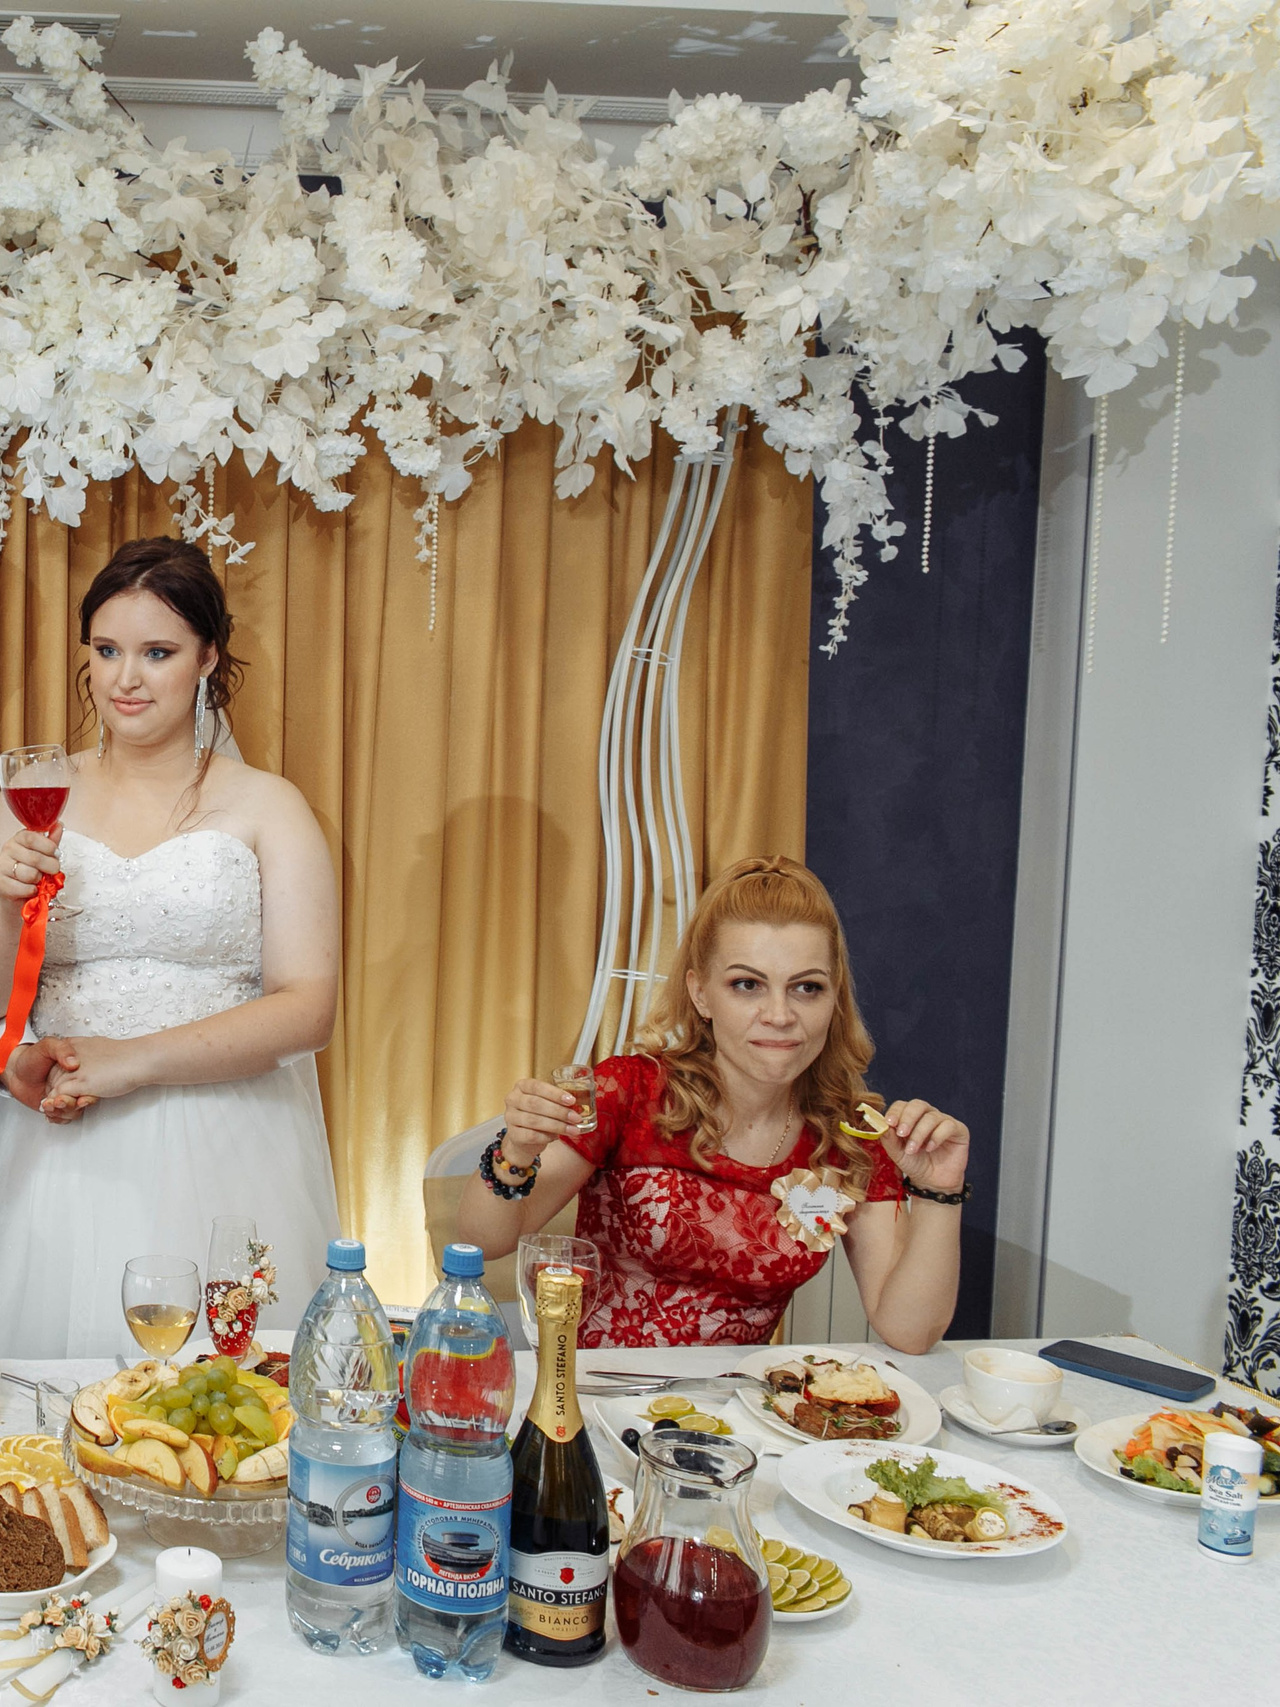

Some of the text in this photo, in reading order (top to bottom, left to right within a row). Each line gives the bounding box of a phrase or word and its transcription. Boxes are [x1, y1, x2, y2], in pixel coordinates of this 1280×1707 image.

[556, 1334, 567, 1415] SANTO STEFANO
[1208, 1485, 1223, 1495] Sea
[1225, 1490, 1243, 1499] Salt
[407, 1568, 454, 1597] ГОРНАЯ
[458, 1576, 504, 1598] ПОЛЯНА
[438, 1569, 480, 1581] ЛЕГЕНДА ВКУСА
[512, 1581, 555, 1603] SANTO
[561, 1584, 605, 1605] STEFANO
[539, 1614, 589, 1626] BIANCO
